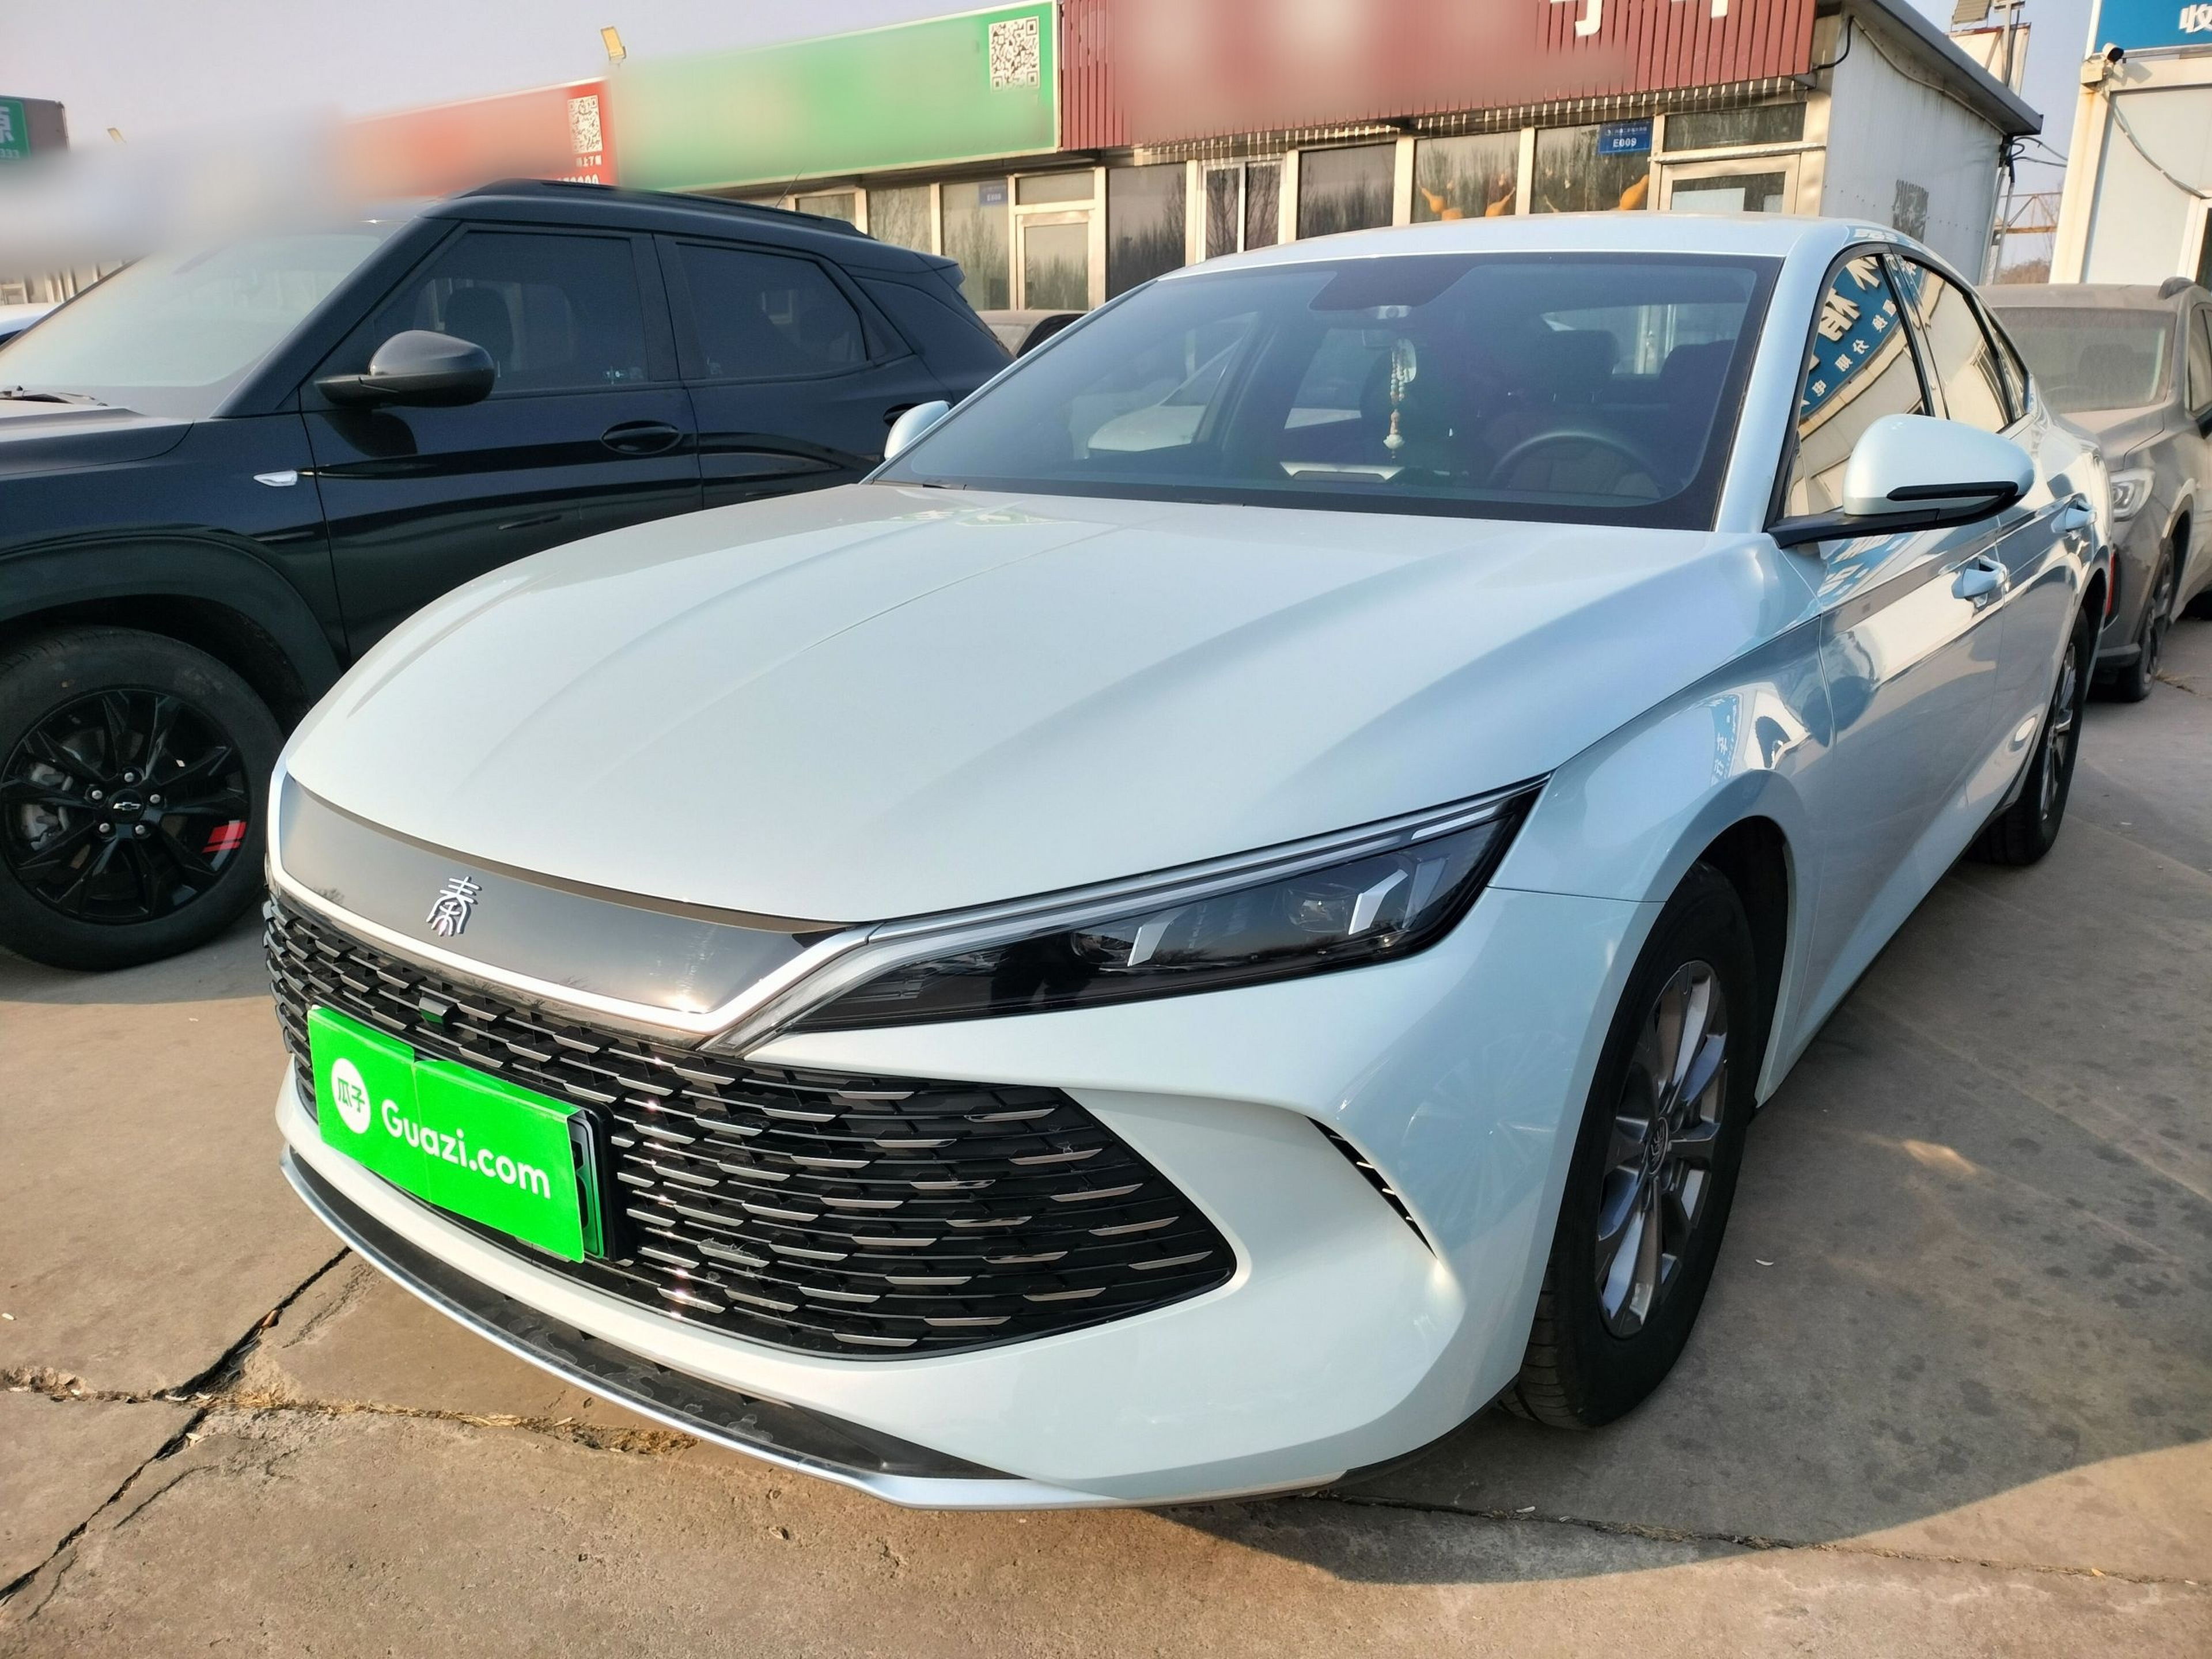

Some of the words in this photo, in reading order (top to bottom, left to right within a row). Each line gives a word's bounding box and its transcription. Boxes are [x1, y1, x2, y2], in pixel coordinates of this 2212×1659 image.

[1613, 138, 1637, 147] E009
[337, 1077, 365, 1113] 瓜子
[381, 1099, 551, 1199] Guazi.com
